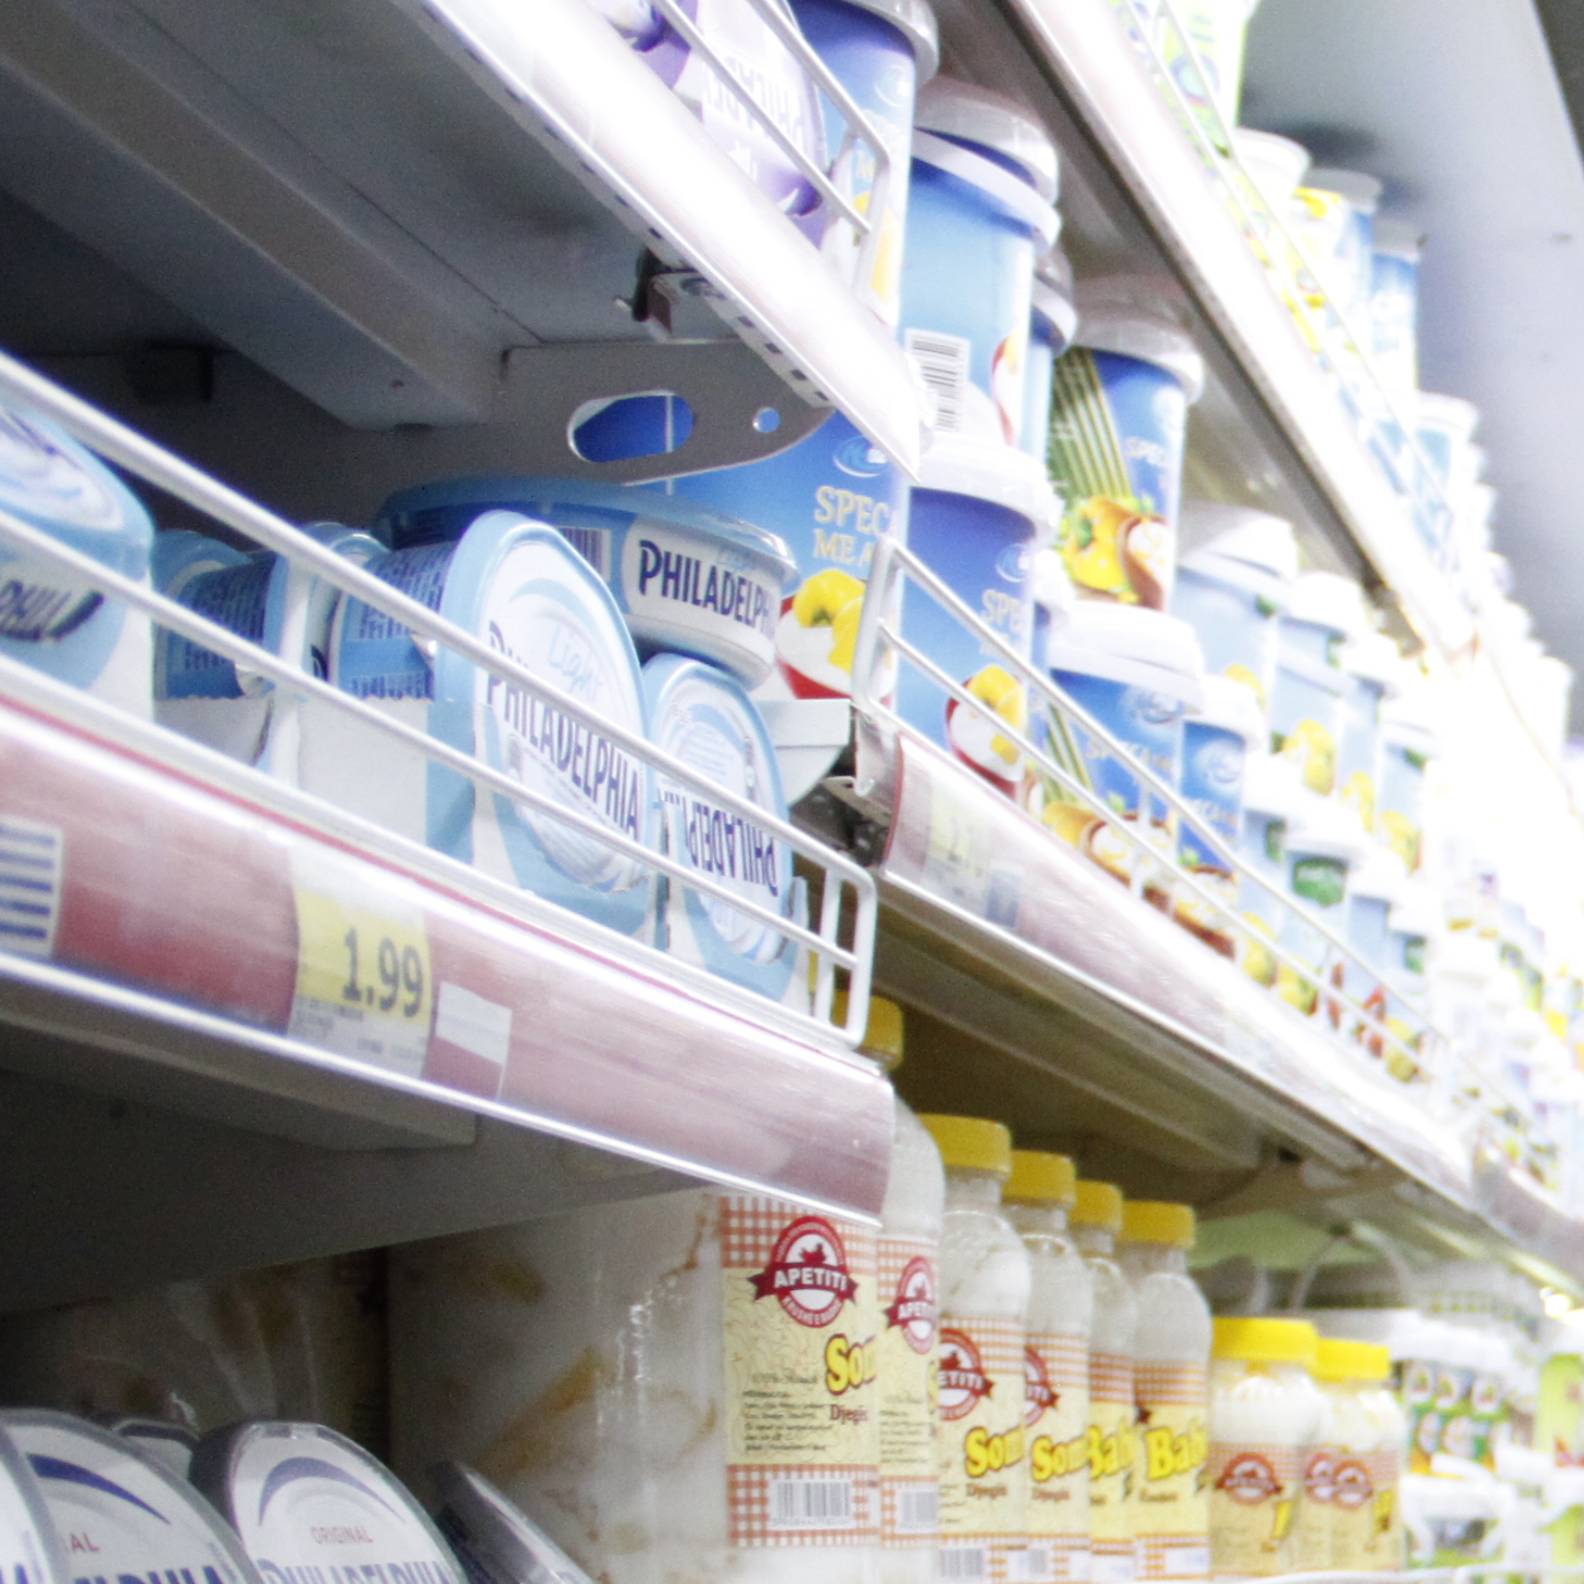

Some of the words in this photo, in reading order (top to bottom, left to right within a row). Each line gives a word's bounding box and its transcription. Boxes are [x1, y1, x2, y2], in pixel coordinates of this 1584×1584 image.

[342, 925, 424, 1018] 1.99
[774, 1266, 849, 1292] APETITI
[310, 1526, 374, 1545] ORIGINAL
